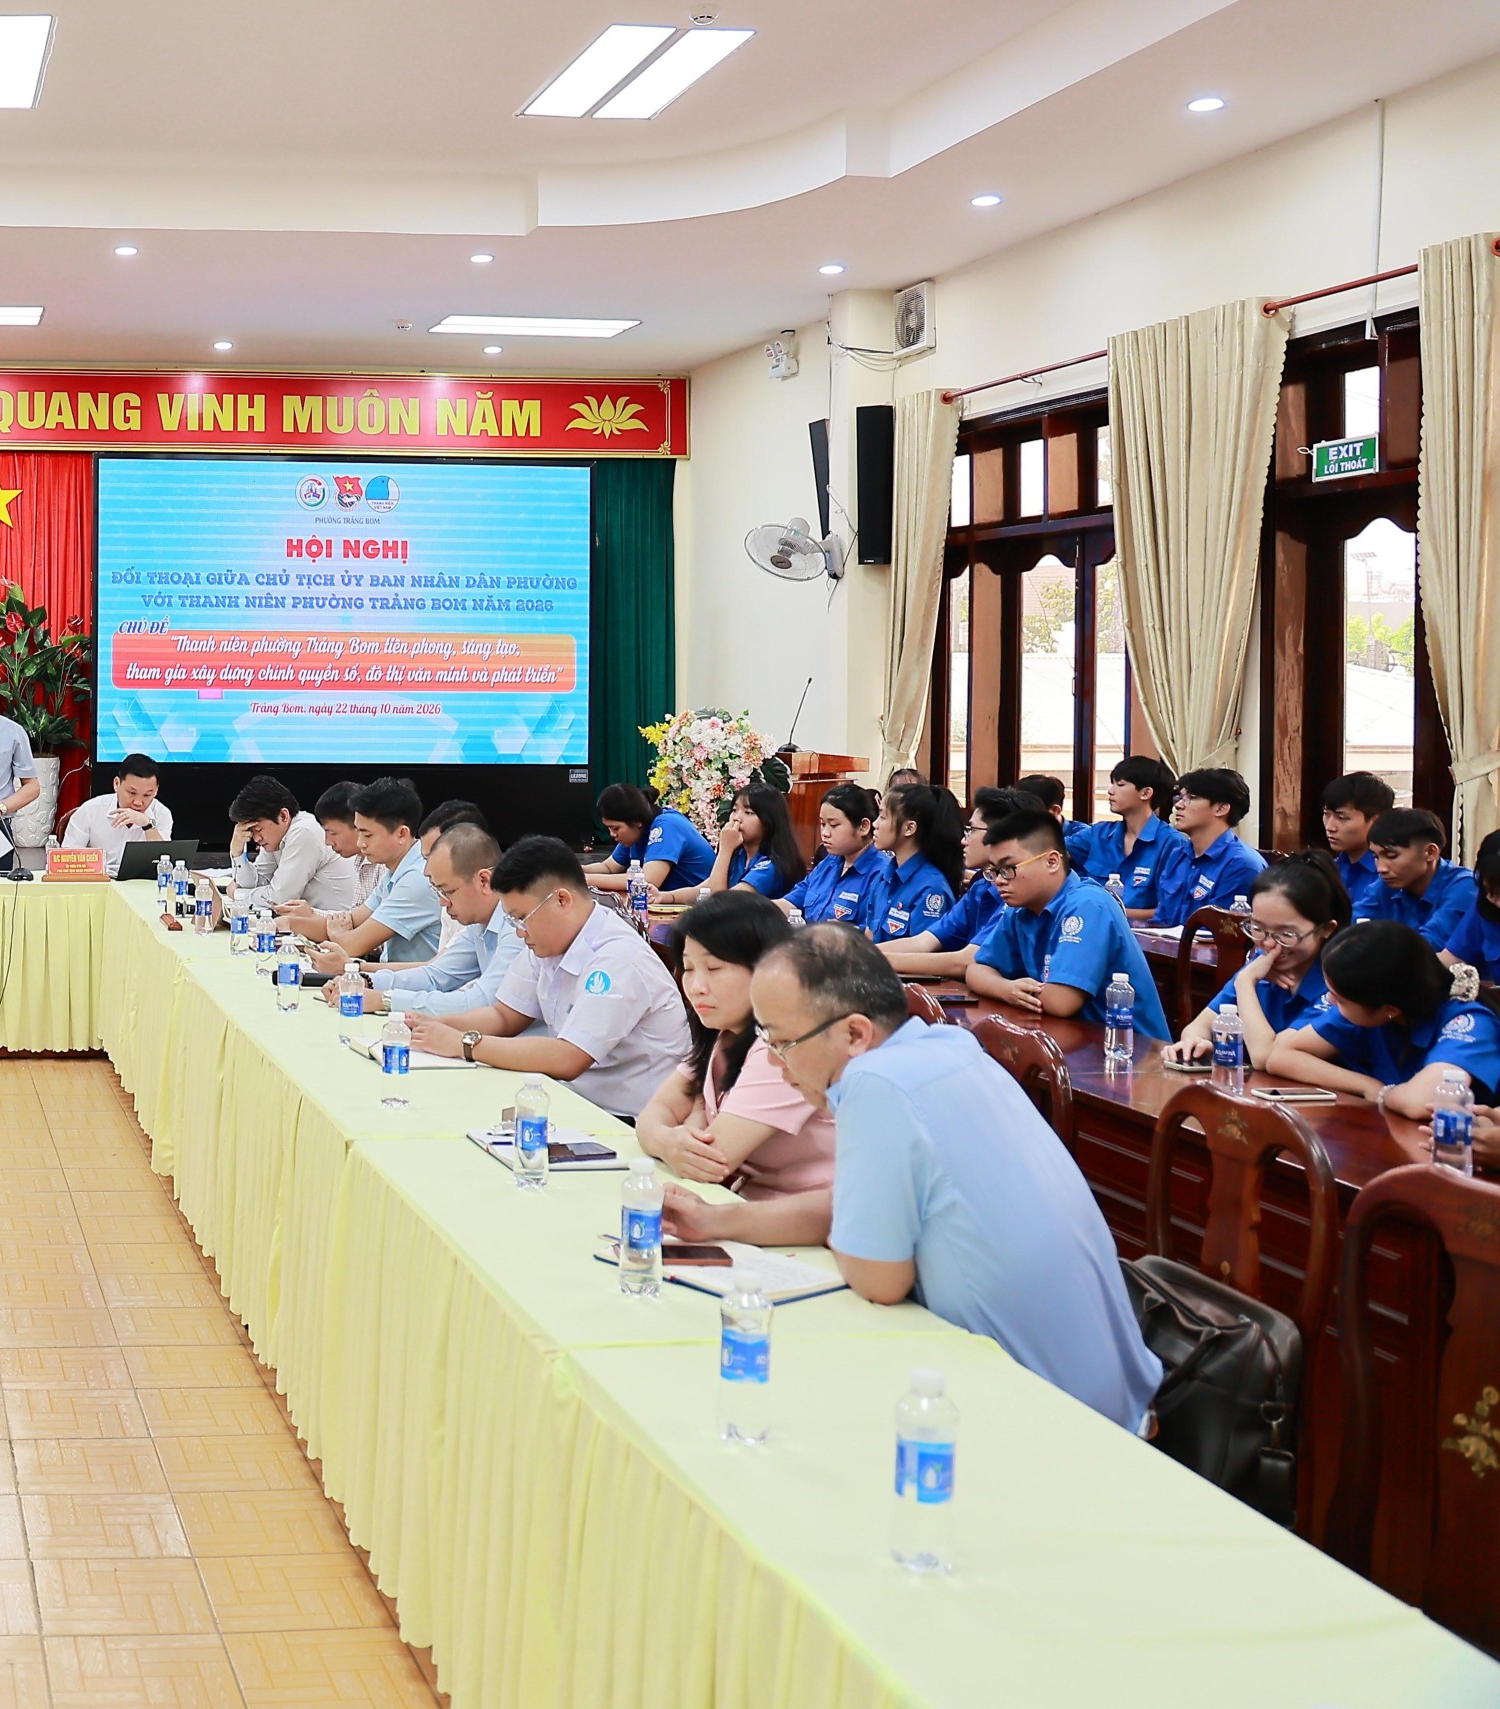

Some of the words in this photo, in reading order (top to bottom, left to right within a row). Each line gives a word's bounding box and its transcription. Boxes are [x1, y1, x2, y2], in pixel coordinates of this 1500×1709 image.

[157, 392, 266, 433] VINH
[282, 388, 421, 436] MUÔN
[436, 389, 543, 438] NĂM
[1328, 442, 1364, 460] EXIT
[1339, 457, 1367, 471] THOÁT
[315, 515, 341, 524] PHƯỜNG
[343, 515, 364, 525] TRẢNG
[286, 534, 332, 563] HỘI
[343, 539, 408, 564] NGHỊ
[111, 566, 141, 585] ĐỐI
[147, 572, 201, 588] THOẠI
[206, 569, 250, 585] GIỮA
[255, 569, 290, 586] CHỦ
[296, 574, 335, 590] TỊCH
[341, 569, 364, 587] ỦY
[369, 575, 405, 588] BAN
[410, 572, 460, 589] NHÂN
[465, 573, 501, 589] DÂN
[506, 575, 578, 590] PHƯỜNG
[141, 591, 173, 608] VỚI
[178, 595, 240, 608] THANH
[245, 592, 286, 609] NIÊN
[291, 593, 365, 609] PHƯỜNG
[369, 593, 426, 610] TRẢNG
[431, 599, 468, 611] BOM
[472, 595, 511, 611] NĂM
[515, 599, 554, 612] 2026
[118, 617, 148, 634] CHỦ
[150, 615, 170, 634] ĐỀ
[170, 635, 217, 653] “Thanh
[219, 638, 248, 653] niên
[250, 637, 301, 659] phường
[306, 637, 345, 659] Trảng
[348, 637, 380, 654] Bom
[384, 638, 409, 654] tiên
[410, 638, 457, 660] phong,
[461, 638, 492, 660] sáng
[496, 639, 521, 659] tạo,
[126, 663, 162, 680] tham
[164, 664, 187, 685] gia
[190, 665, 218, 686] xây
[219, 665, 256, 687] dựng
[258, 664, 296, 681] chính
[298, 662, 341, 686] quyền
[343, 663, 361, 683] số,
[366, 665, 384, 682] đô
[386, 665, 405, 684] thị
[407, 667, 433, 682] văn
[434, 666, 470, 682] minh
[472, 667, 489, 682] và
[491, 666, 523, 686] phát
[524, 664, 563, 683] triển”
[250, 702, 279, 716] Trảng
[282, 703, 306, 714] Bom,
[308, 703, 333, 716] ngày
[335, 704, 348, 714] 22
[349, 703, 377, 716] tháng
[380, 703, 391, 714] 10
[392, 704, 414, 714] năm
[416, 704, 441, 714] 2026
[1215, 1049, 1236, 1057] AQUAFINA
